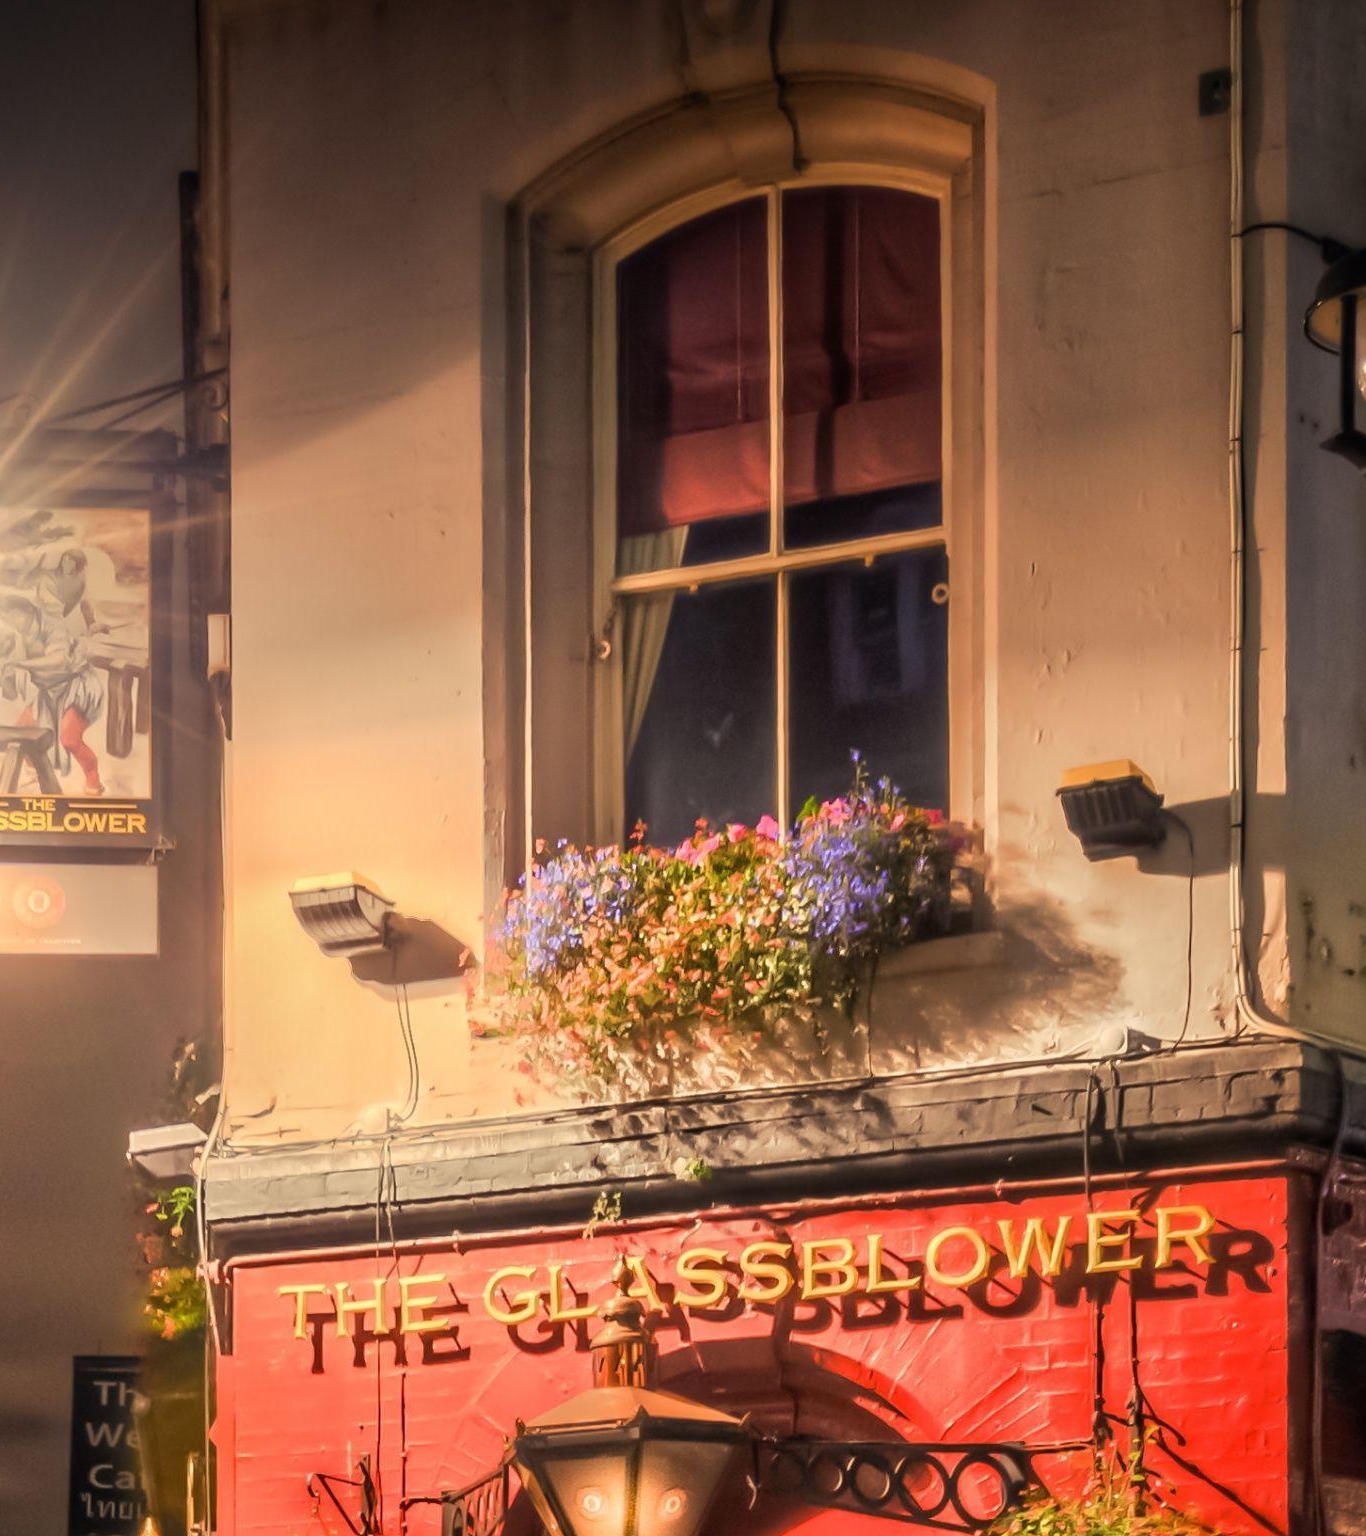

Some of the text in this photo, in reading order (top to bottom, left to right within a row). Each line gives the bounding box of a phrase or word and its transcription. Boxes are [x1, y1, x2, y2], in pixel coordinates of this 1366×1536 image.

[22, 798, 56, 812] THE
[278, 1204, 1217, 1340] THE GLASSBLOWER
[93, 1381, 135, 1407] Th
[85, 1421, 140, 1448] We
[89, 1464, 136, 1490] Ca
